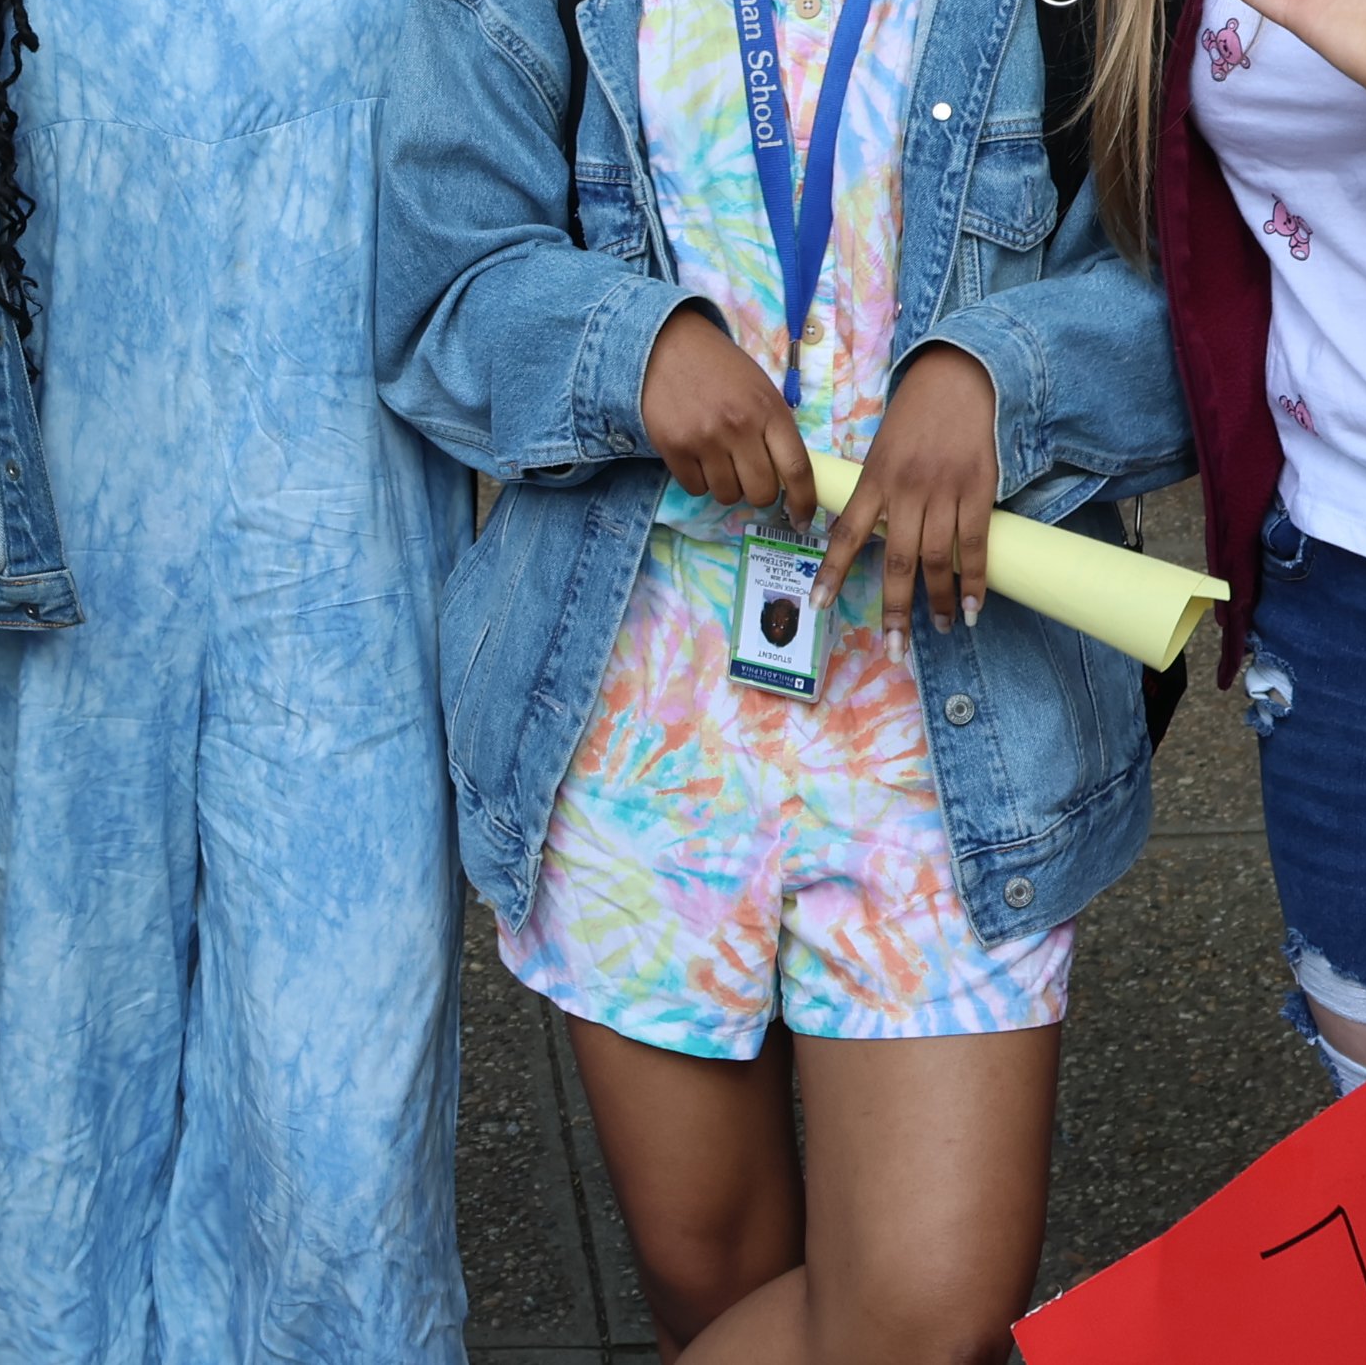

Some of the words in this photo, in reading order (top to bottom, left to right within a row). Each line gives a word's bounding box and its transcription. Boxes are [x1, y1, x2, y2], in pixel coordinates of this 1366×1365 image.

[747, 50, 783, 150] School
[754, 578, 783, 592] NEWTON
[757, 650, 792, 664] STUDENT
[740, 664, 794, 683] PHILADELPHIA
